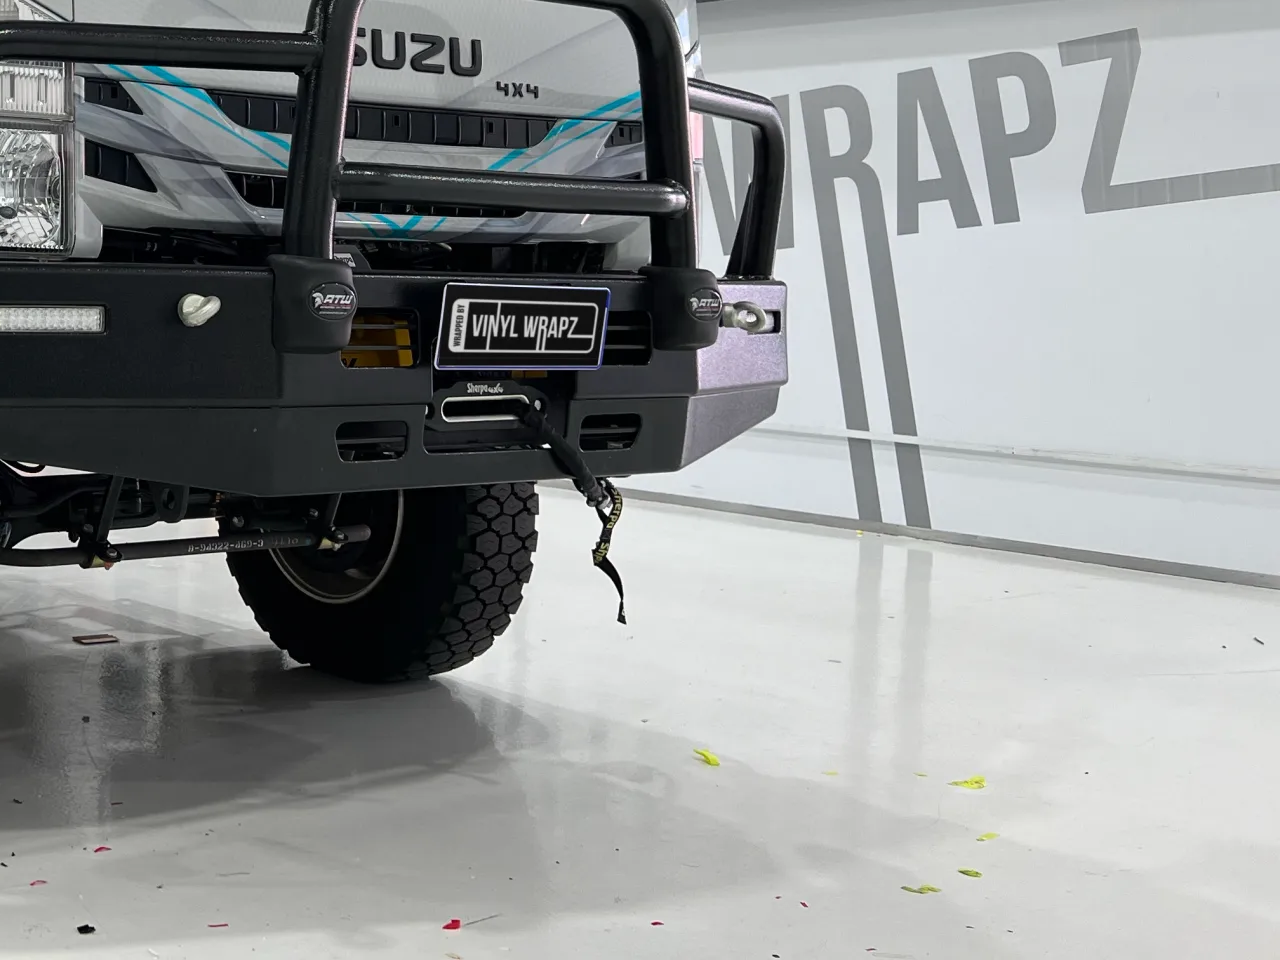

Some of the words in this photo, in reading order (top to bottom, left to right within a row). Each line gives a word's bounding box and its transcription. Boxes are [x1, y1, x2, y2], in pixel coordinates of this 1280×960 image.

[323, 294, 354, 305] ATW
[457, 304, 466, 313] BY
[453, 314, 465, 347] WRAPPED
[472, 314, 518, 338] VINYL
[523, 316, 579, 339] WRAPZ
